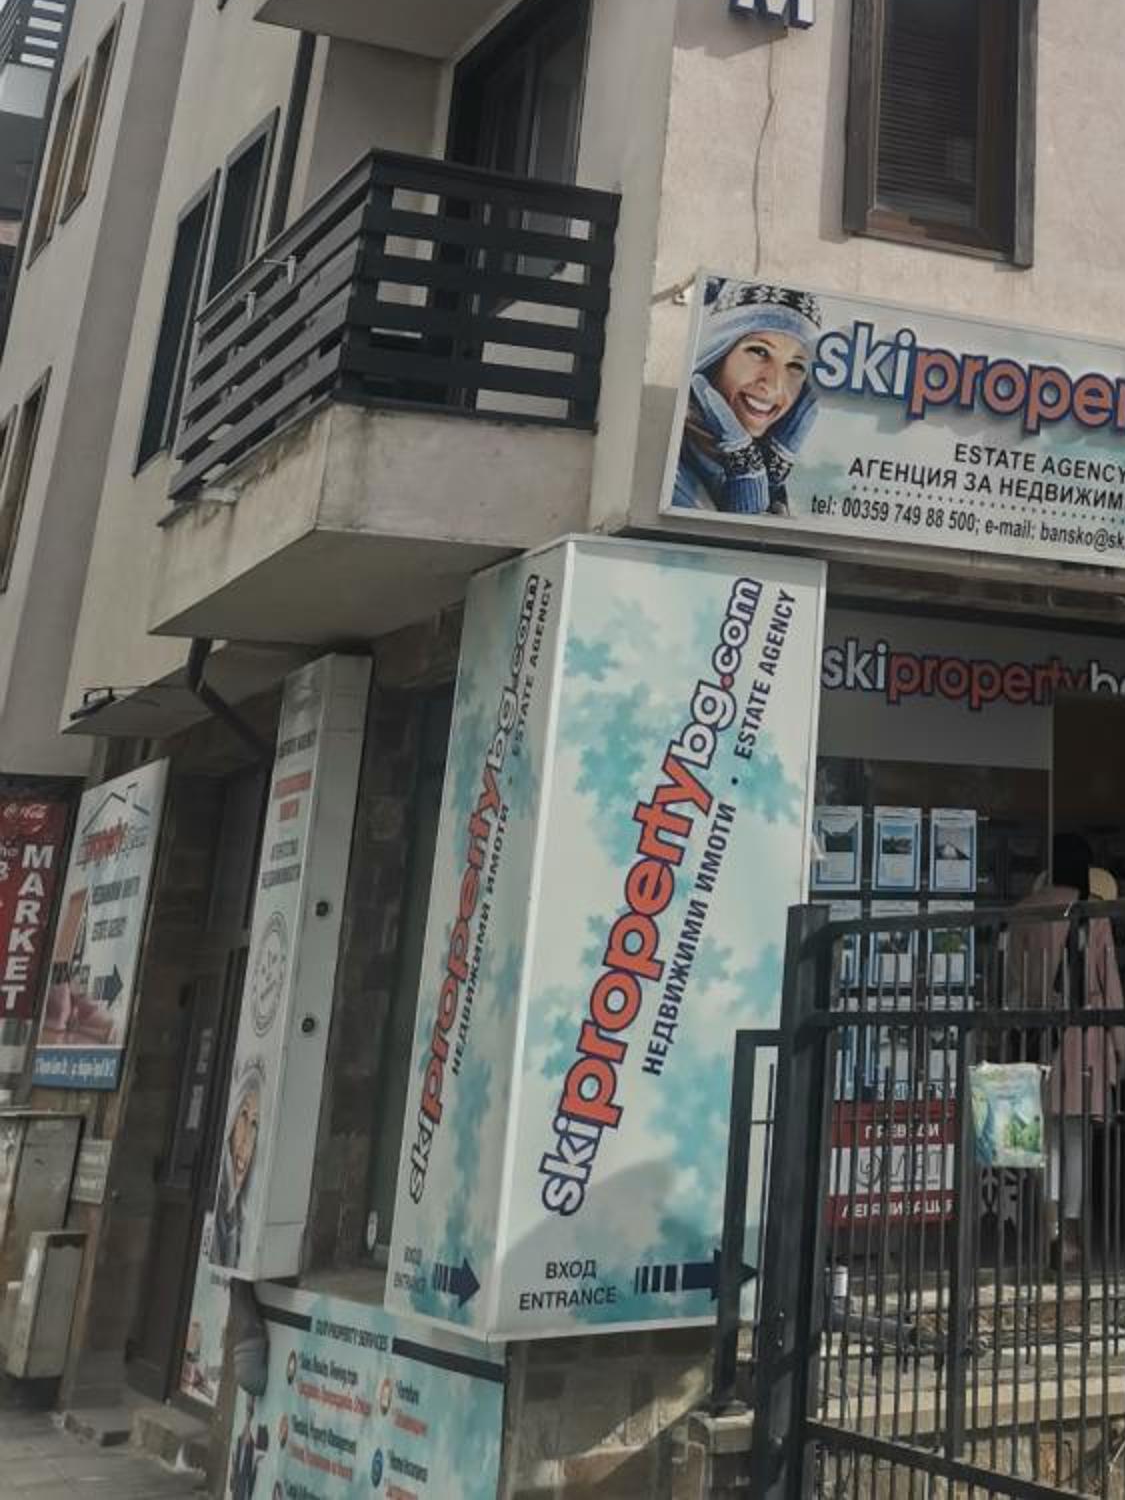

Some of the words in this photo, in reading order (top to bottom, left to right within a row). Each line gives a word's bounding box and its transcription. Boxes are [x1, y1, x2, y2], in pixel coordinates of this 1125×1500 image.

[848, 457, 957, 490] АГЕНЦИЯ
[963, 473, 992, 495] ЗА
[955, 443, 1036, 473] ESTATE
[811, 495, 835, 516] tel:
[841, 498, 889, 521] 00359
[894, 503, 922, 526] 749
[925, 508, 944, 529] 88
[985, 514, 1036, 539] e-mail:
[641, 900, 709, 1077] НЕДВИЖИМИ
[694, 803, 737, 894] ИМОТИ
[734, 678, 771, 761] ESTATE
[756, 588, 797, 677] AGENCY
[538, 576, 763, 1217] skipropertybg.com
[1, 844, 55, 1011] MARKET
[545, 1259, 597, 1281] ВХОД
[519, 1286, 617, 1311] ENTRANCE
